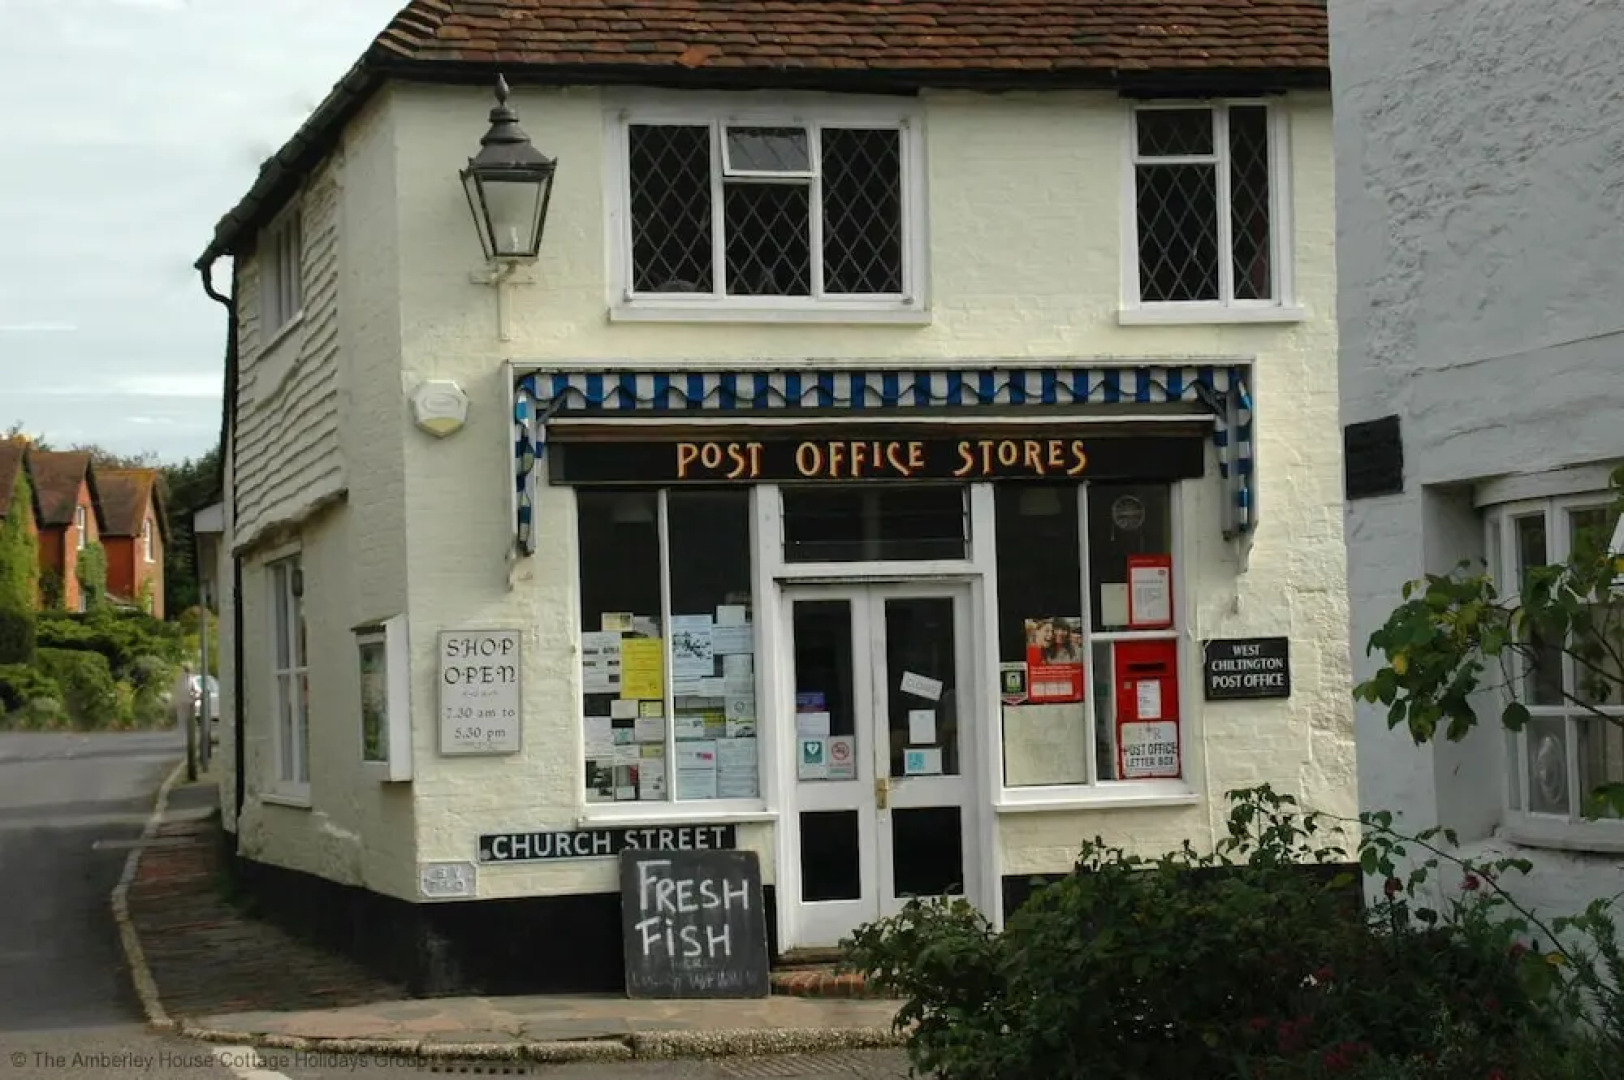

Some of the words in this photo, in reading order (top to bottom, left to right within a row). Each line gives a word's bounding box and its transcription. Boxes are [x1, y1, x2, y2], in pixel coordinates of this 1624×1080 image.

[676, 442, 763, 479] POST
[796, 440, 925, 478] OFFICE
[953, 439, 1088, 476] STORES
[446, 638, 514, 658] SHOP
[1232, 644, 1261, 656] WEST
[1211, 658, 1284, 671] CHILTINGTON
[444, 665, 516, 685] OPEN
[1212, 674, 1242, 689] POST
[1243, 673, 1284, 687] OFFICE
[502, 706, 516, 718] to
[454, 727, 482, 739] 5.30
[486, 729, 506, 742] pm
[1148, 742, 1177, 755] OFFICE
[491, 832, 612, 859] CHURCH
[624, 826, 727, 850] STREET
[636, 860, 749, 912] FRESH
